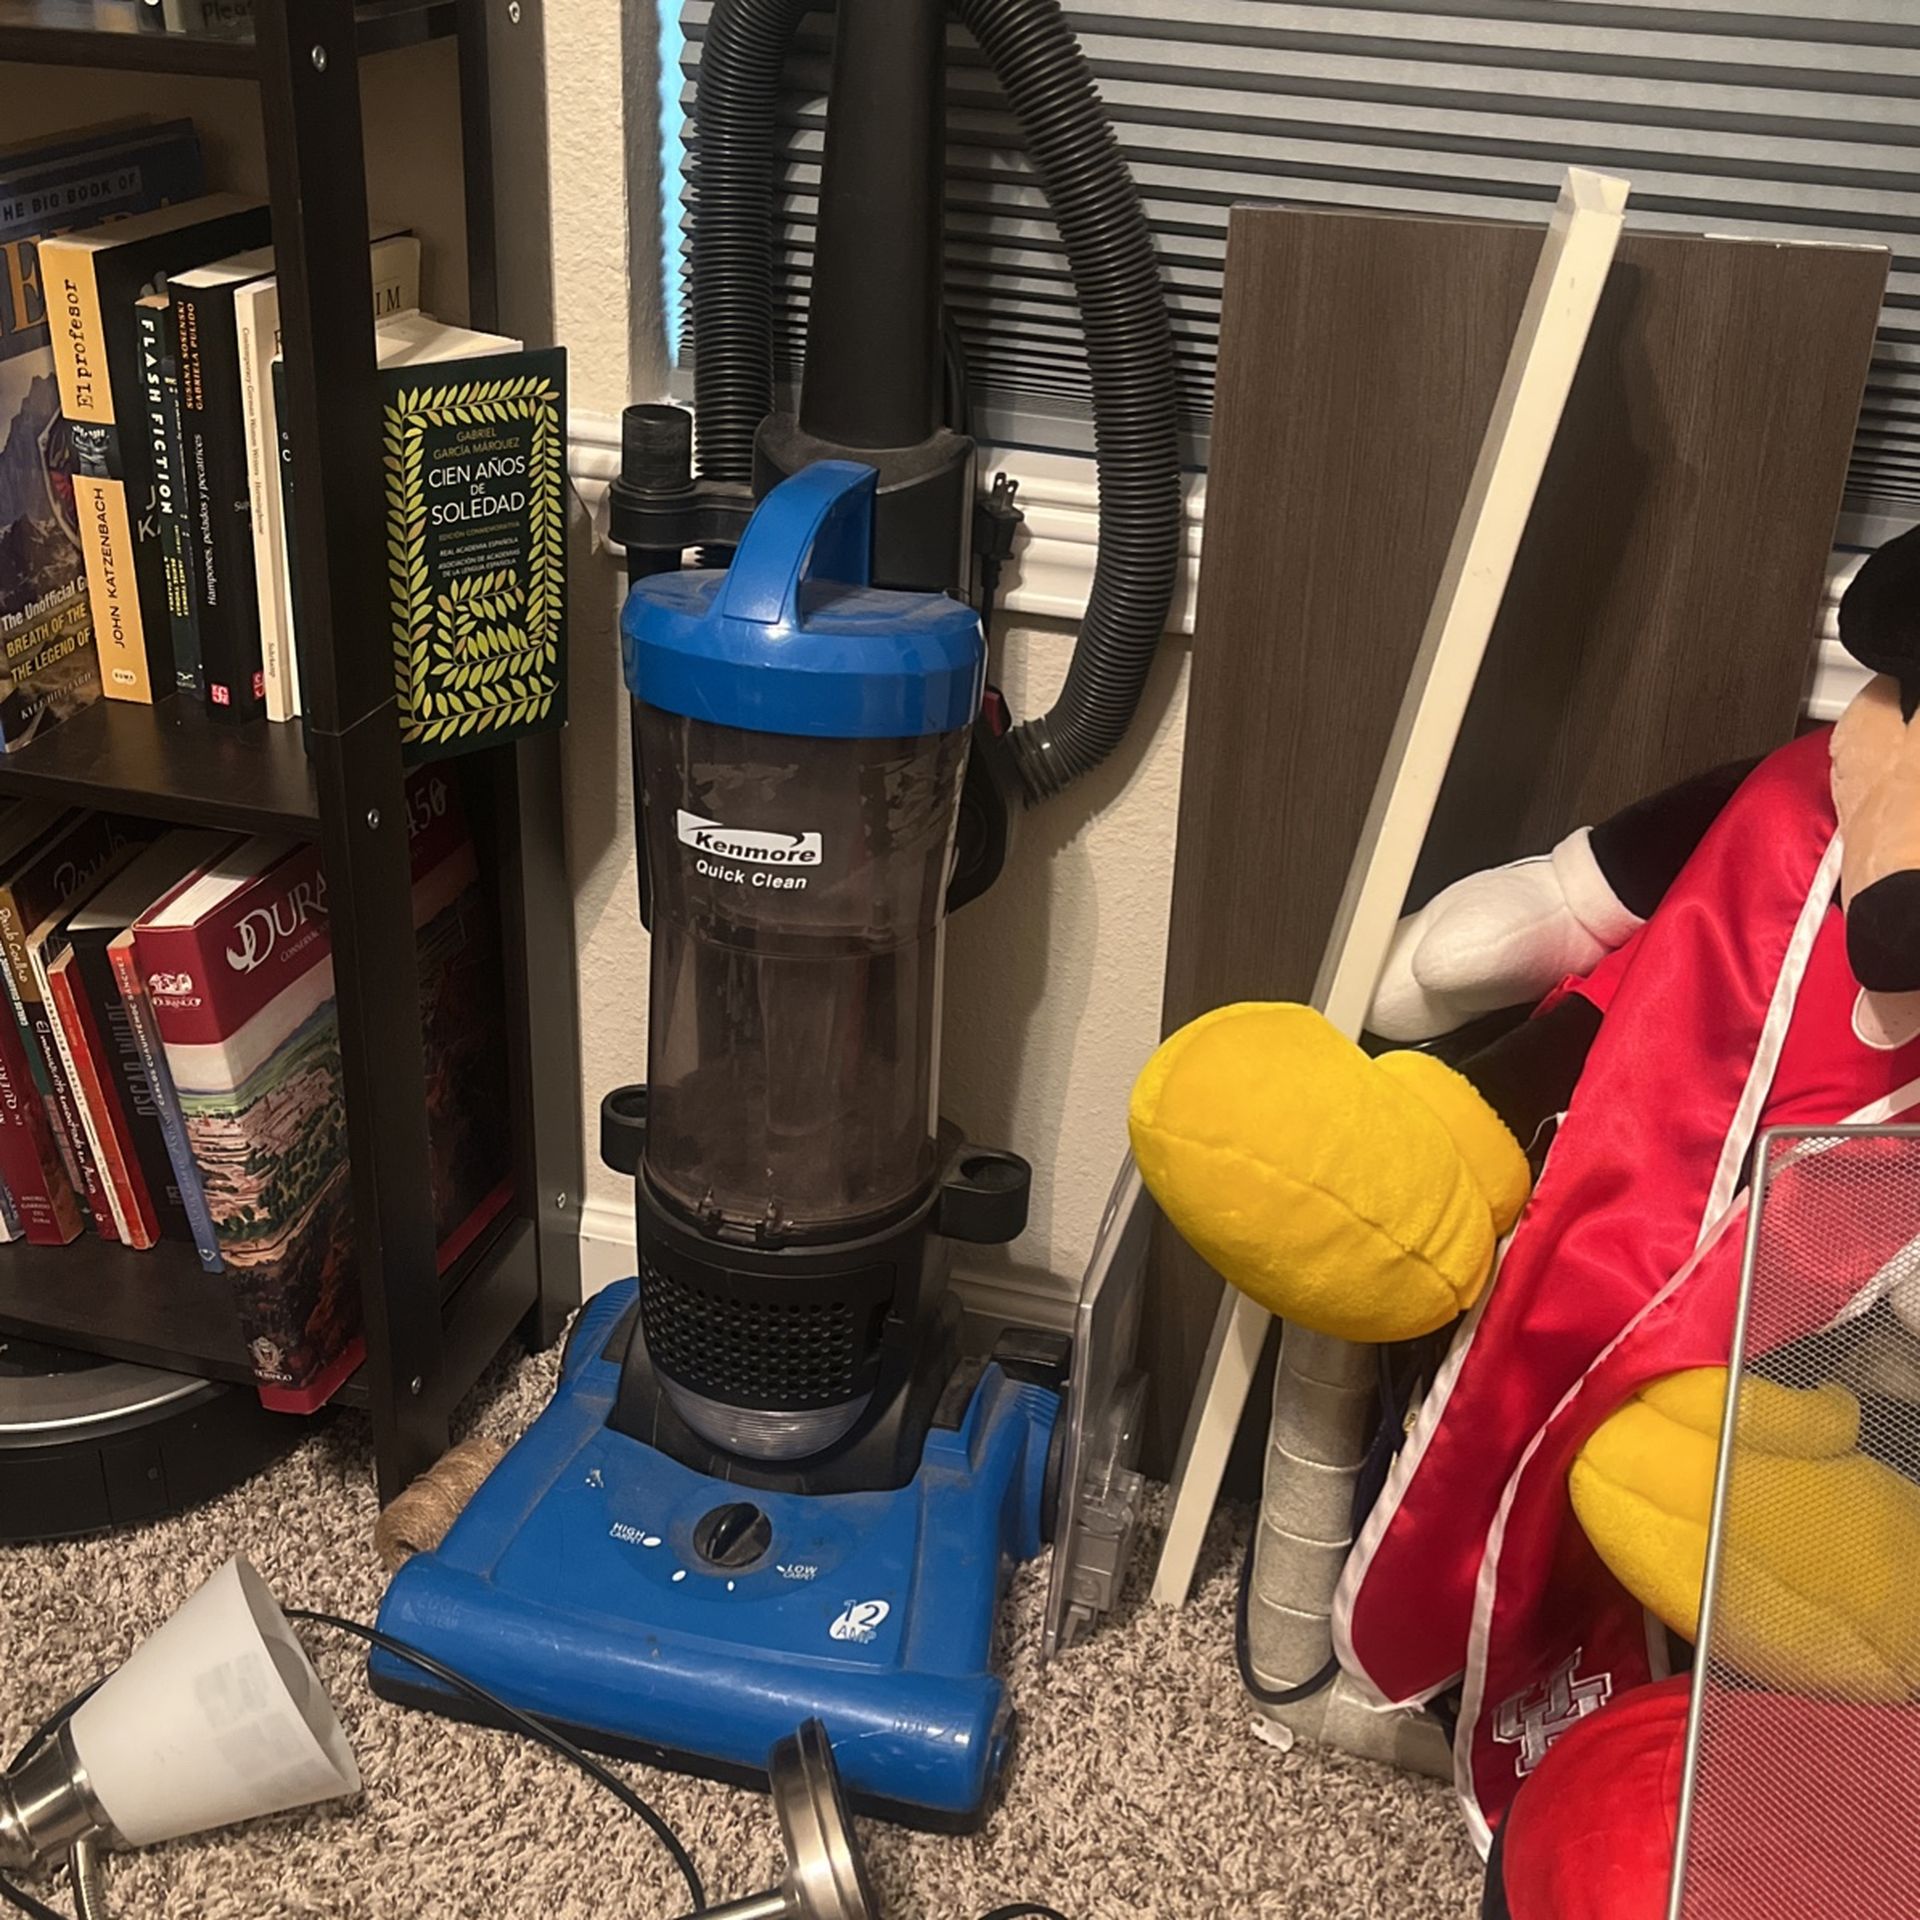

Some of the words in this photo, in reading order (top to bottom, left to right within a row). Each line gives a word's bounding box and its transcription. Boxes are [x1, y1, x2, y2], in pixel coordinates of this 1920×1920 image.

[2, 203, 25, 222] HE
[32, 193, 60, 214] BIG
[67, 181, 113, 205] BOOK
[118, 172, 137, 190] OF
[64, 279, 93, 381] profesor
[177, 301, 189, 360] SOSENSKI
[187, 302, 199, 349] PULIDO
[141, 319, 162, 404] FLASH
[191, 352, 204, 411] GABRIELA
[77, 383, 95, 410] El
[182, 363, 194, 410] SUSANA
[433, 443, 471, 460] GARCÍA
[472, 437, 520, 454] MÁRQUEZ
[456, 427, 497, 442] GABRIEL
[151, 413, 173, 515] FICTION
[428, 464, 471, 488] CIEN
[474, 455, 526, 481] AÑOS
[431, 491, 526, 526] SOLEDAD
[470, 482, 486, 496] DE
[94, 487, 118, 599] KATZENBACH
[198, 501, 213, 546] pelados
[440, 548, 454, 557] REAL
[455, 543, 487, 554] ACADEMIA
[2, 611, 24, 632] The
[24, 580, 75, 620] Unofficial
[112, 606, 125, 649] JOHN
[6, 622, 50, 659] BREATH
[50, 613, 65, 633] OF
[66, 602, 88, 624] THE
[11, 659, 33, 684] THE
[34, 636, 76, 671] LEGEND
[77, 626, 91, 648] OF
[695, 830, 816, 863] Kenmore
[696, 859, 746, 885] Quick
[751, 871, 807, 890] Clean
[225, 869, 330, 976] DURA
[149, 1068, 165, 1107] CARLOS
[612, 1521, 646, 1541] HIGH
[786, 1563, 818, 1575] LOW
[835, 1624, 878, 1645] AMP
[843, 1599, 881, 1628] 12
